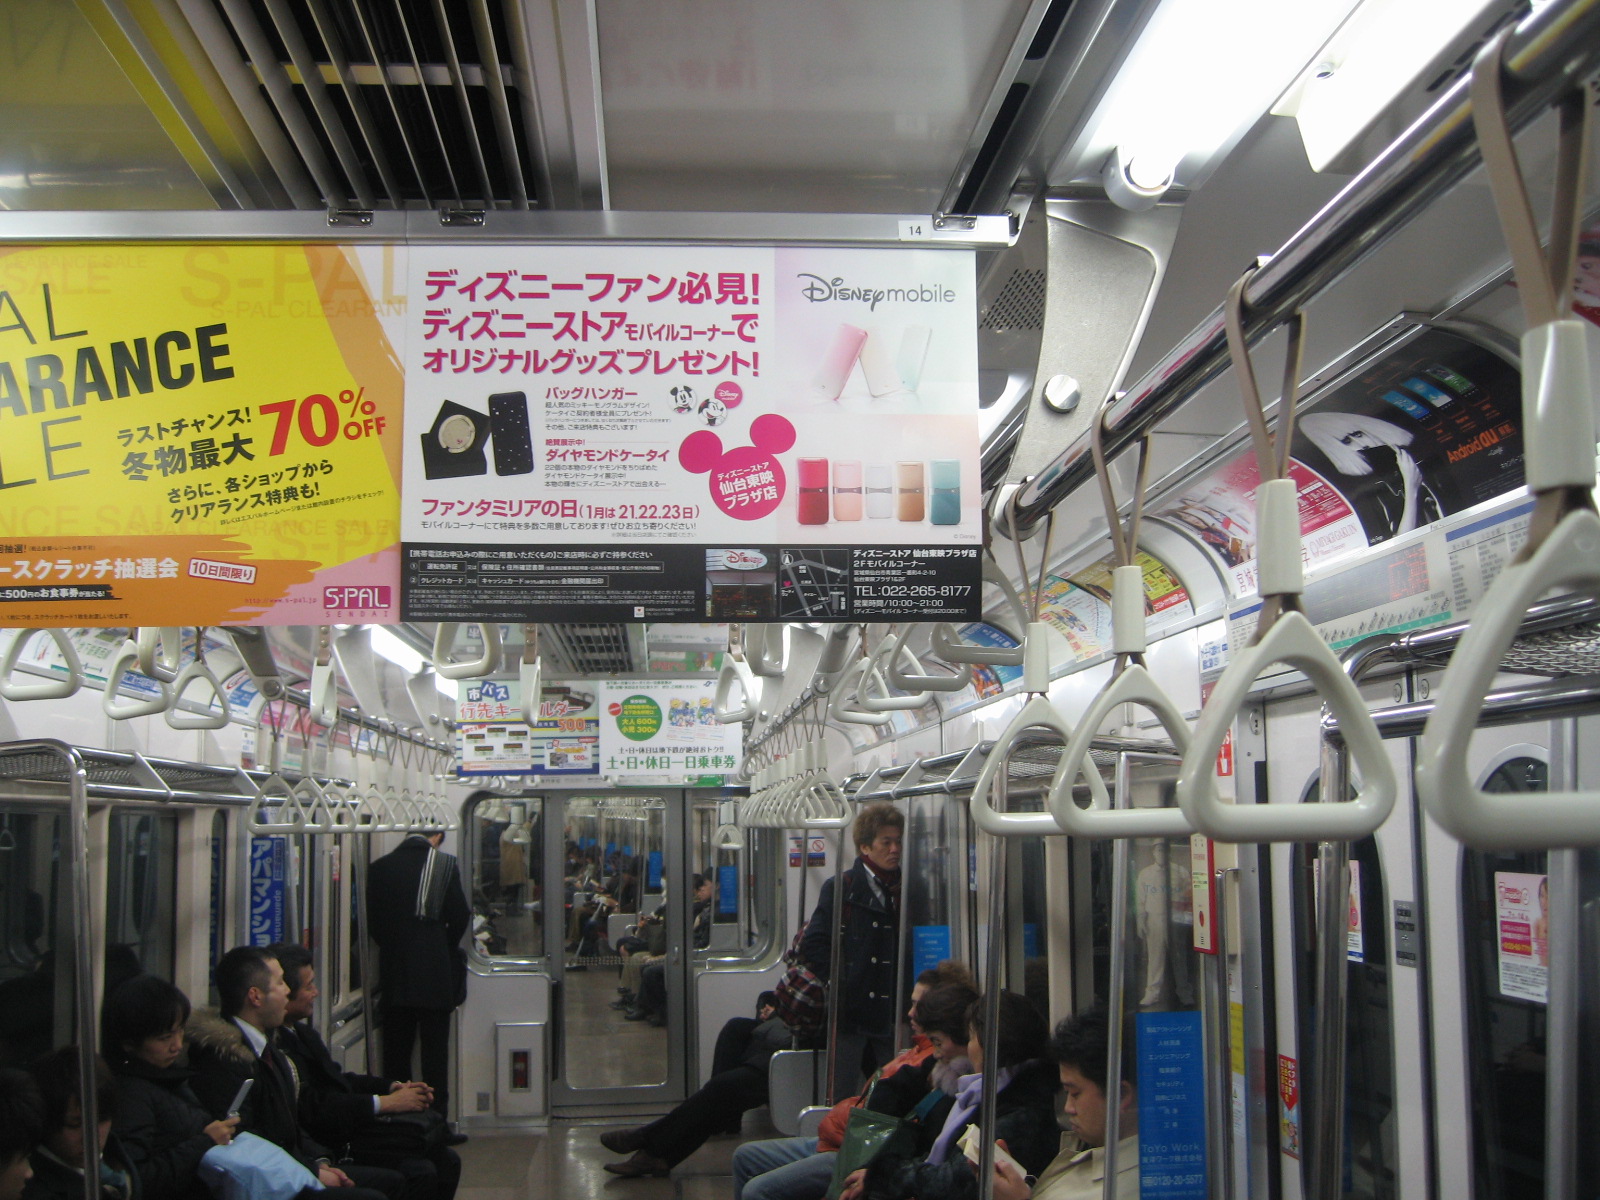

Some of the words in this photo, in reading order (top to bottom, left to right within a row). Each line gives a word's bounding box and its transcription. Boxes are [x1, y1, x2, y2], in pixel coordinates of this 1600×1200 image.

[909, 225, 922, 236] 14
[424, 269, 760, 306] ディズニーファン必見!
[886, 283, 957, 303] mobile
[423, 307, 760, 344] ディズニーストアモバイルコーナーで
[422, 347, 760, 377] オリジナルグッズプレゼント!
[545, 387, 638, 400] バッグハンガー
[117, 406, 252, 447] ラストチャンス!
[343, 416, 386, 441] OFF
[121, 432, 256, 482] 冬物最大
[545, 449, 670, 462] ダイヤモンドケータイ
[167, 459, 334, 504] さらに、各ショップから
[717, 462, 769, 481] ディズニーストア
[719, 470, 776, 496] 仙台東映
[170, 482, 320, 524] クリアランス特典も!
[724, 485, 778, 510] プラザ店
[853, 549, 912, 558] ディズニーストア
[912, 549, 978, 558] 仙台東映プラザ店
[192, 561, 253, 581] 10日間限り
[853, 585, 972, 597] TEL:022-265-8177
[460, 700, 584, 719] 行先キールダー
[606, 756, 737, 770] 土・日・休日一日乗車券
